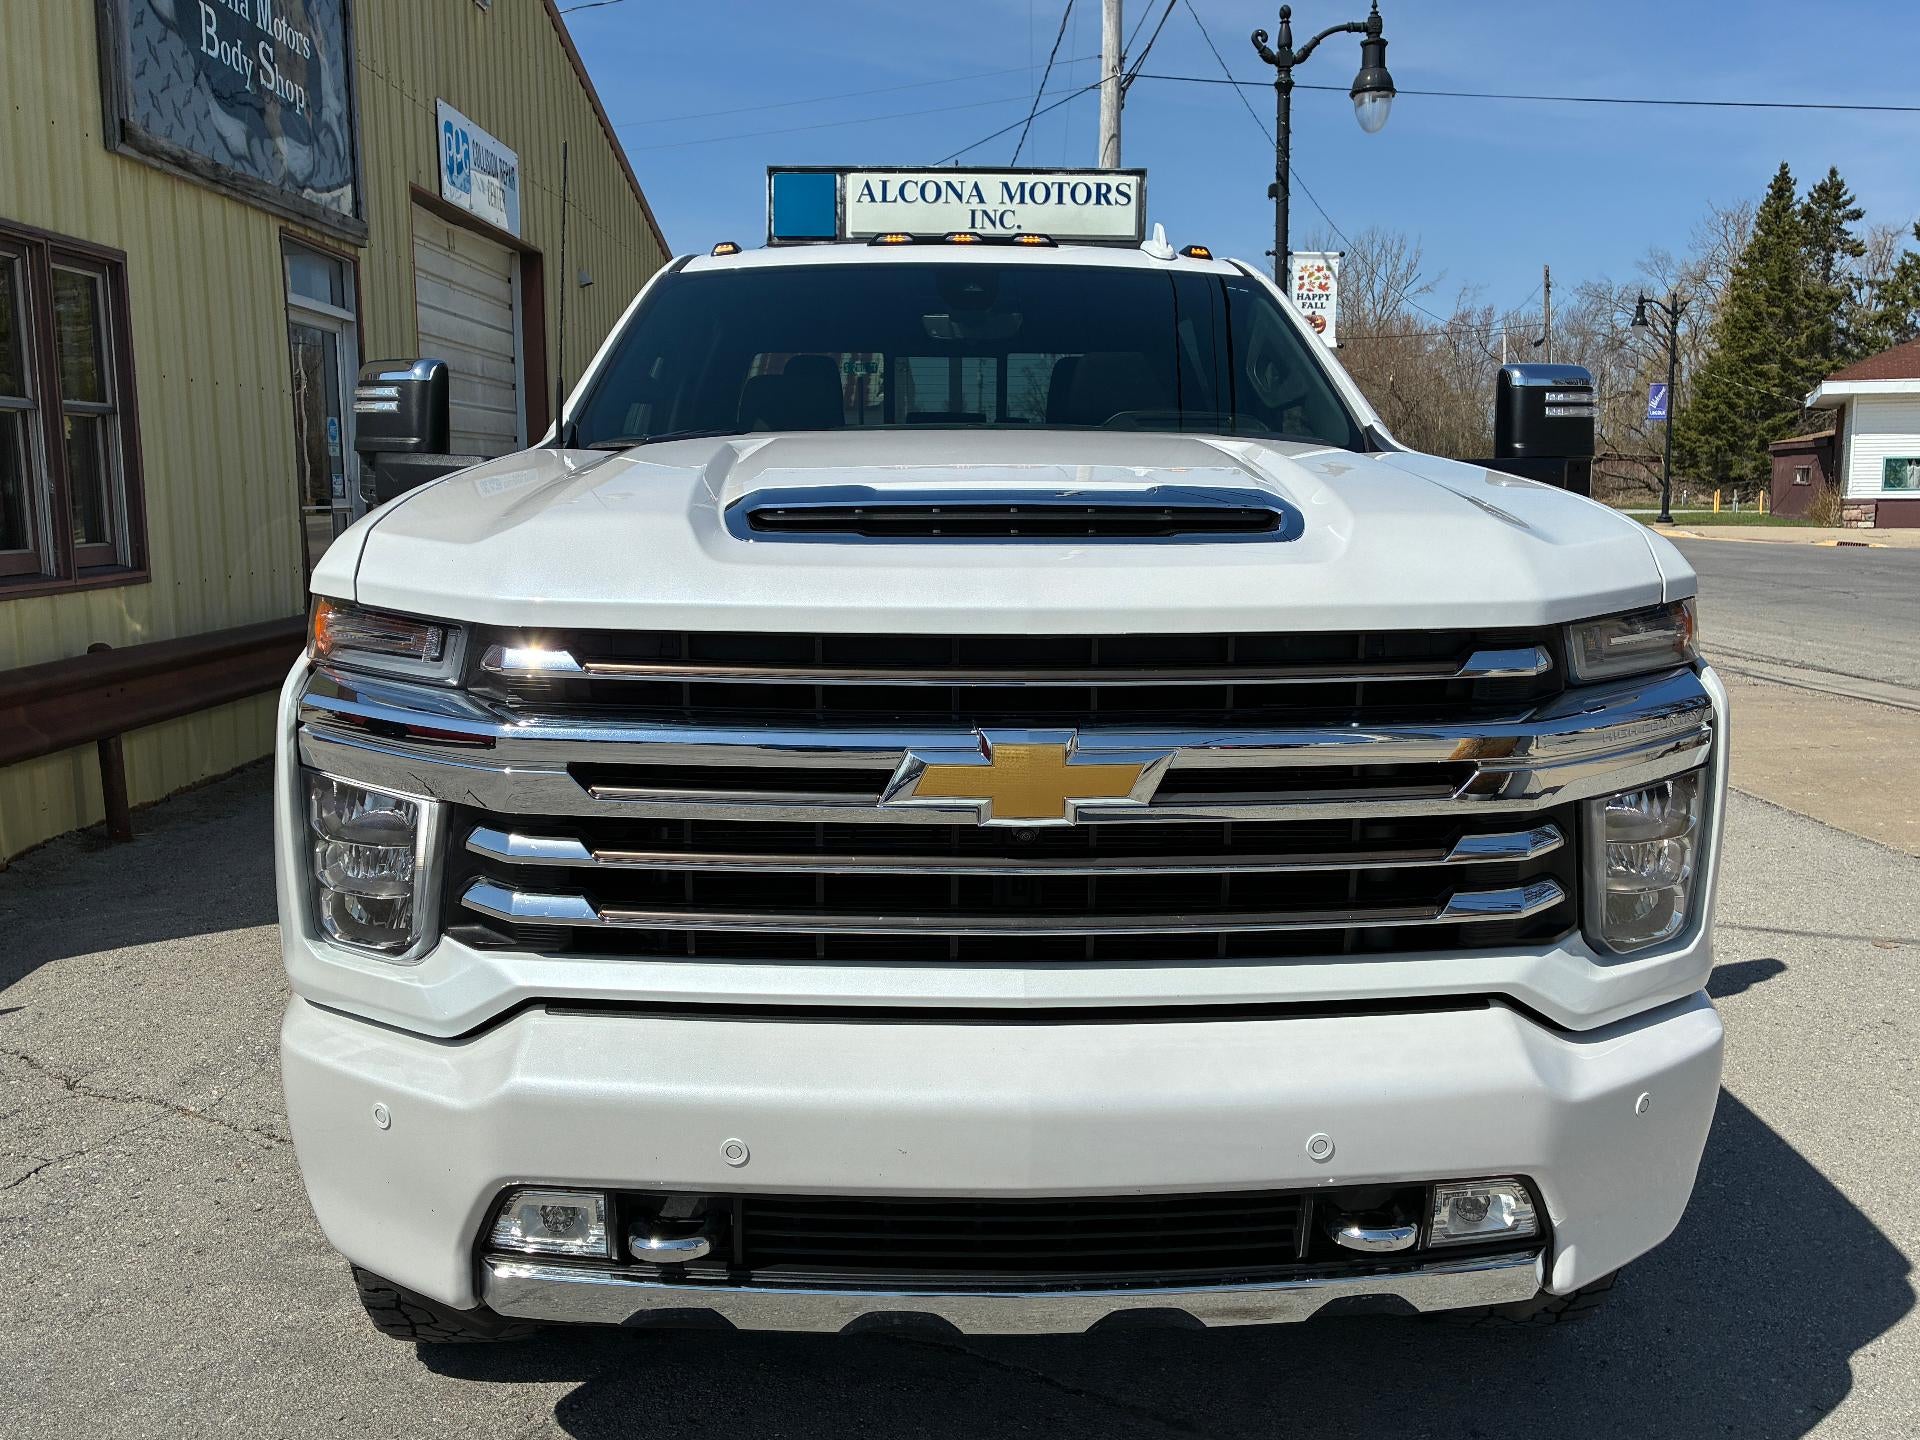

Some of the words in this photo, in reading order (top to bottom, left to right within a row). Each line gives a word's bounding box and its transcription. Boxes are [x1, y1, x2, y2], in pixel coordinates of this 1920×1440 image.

[256, 0, 311, 60] Motors
[199, 1, 254, 91] Body
[258, 41, 305, 115] Shop
[856, 179, 986, 205] ALCONA
[998, 180, 1132, 207] MOTORS
[968, 209, 1022, 230] INC.
[1296, 293, 1331, 301] HAPPY
[1301, 301, 1326, 310] FALL
[1602, 728, 1638, 743] HIGH
